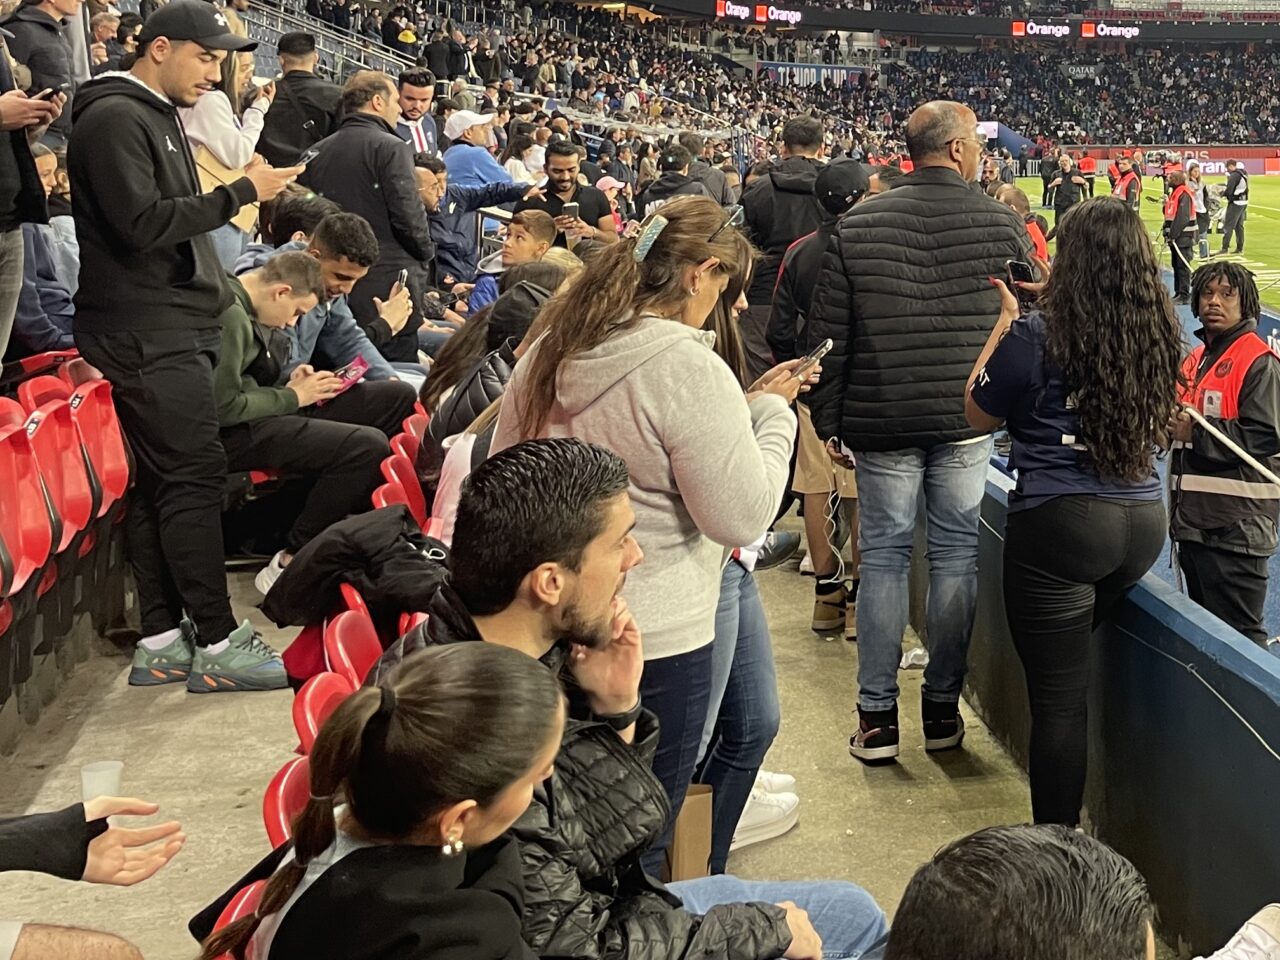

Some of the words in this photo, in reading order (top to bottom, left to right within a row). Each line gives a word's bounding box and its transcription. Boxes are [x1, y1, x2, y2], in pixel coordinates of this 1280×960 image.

[725, 0, 750, 20] Orange
[768, 6, 802, 24] Orange
[1026, 22, 1070, 38] Orange
[1096, 23, 1140, 39] Orange
[1068, 66, 1095, 75] QATAR
[1186, 159, 1245, 176] Orane
